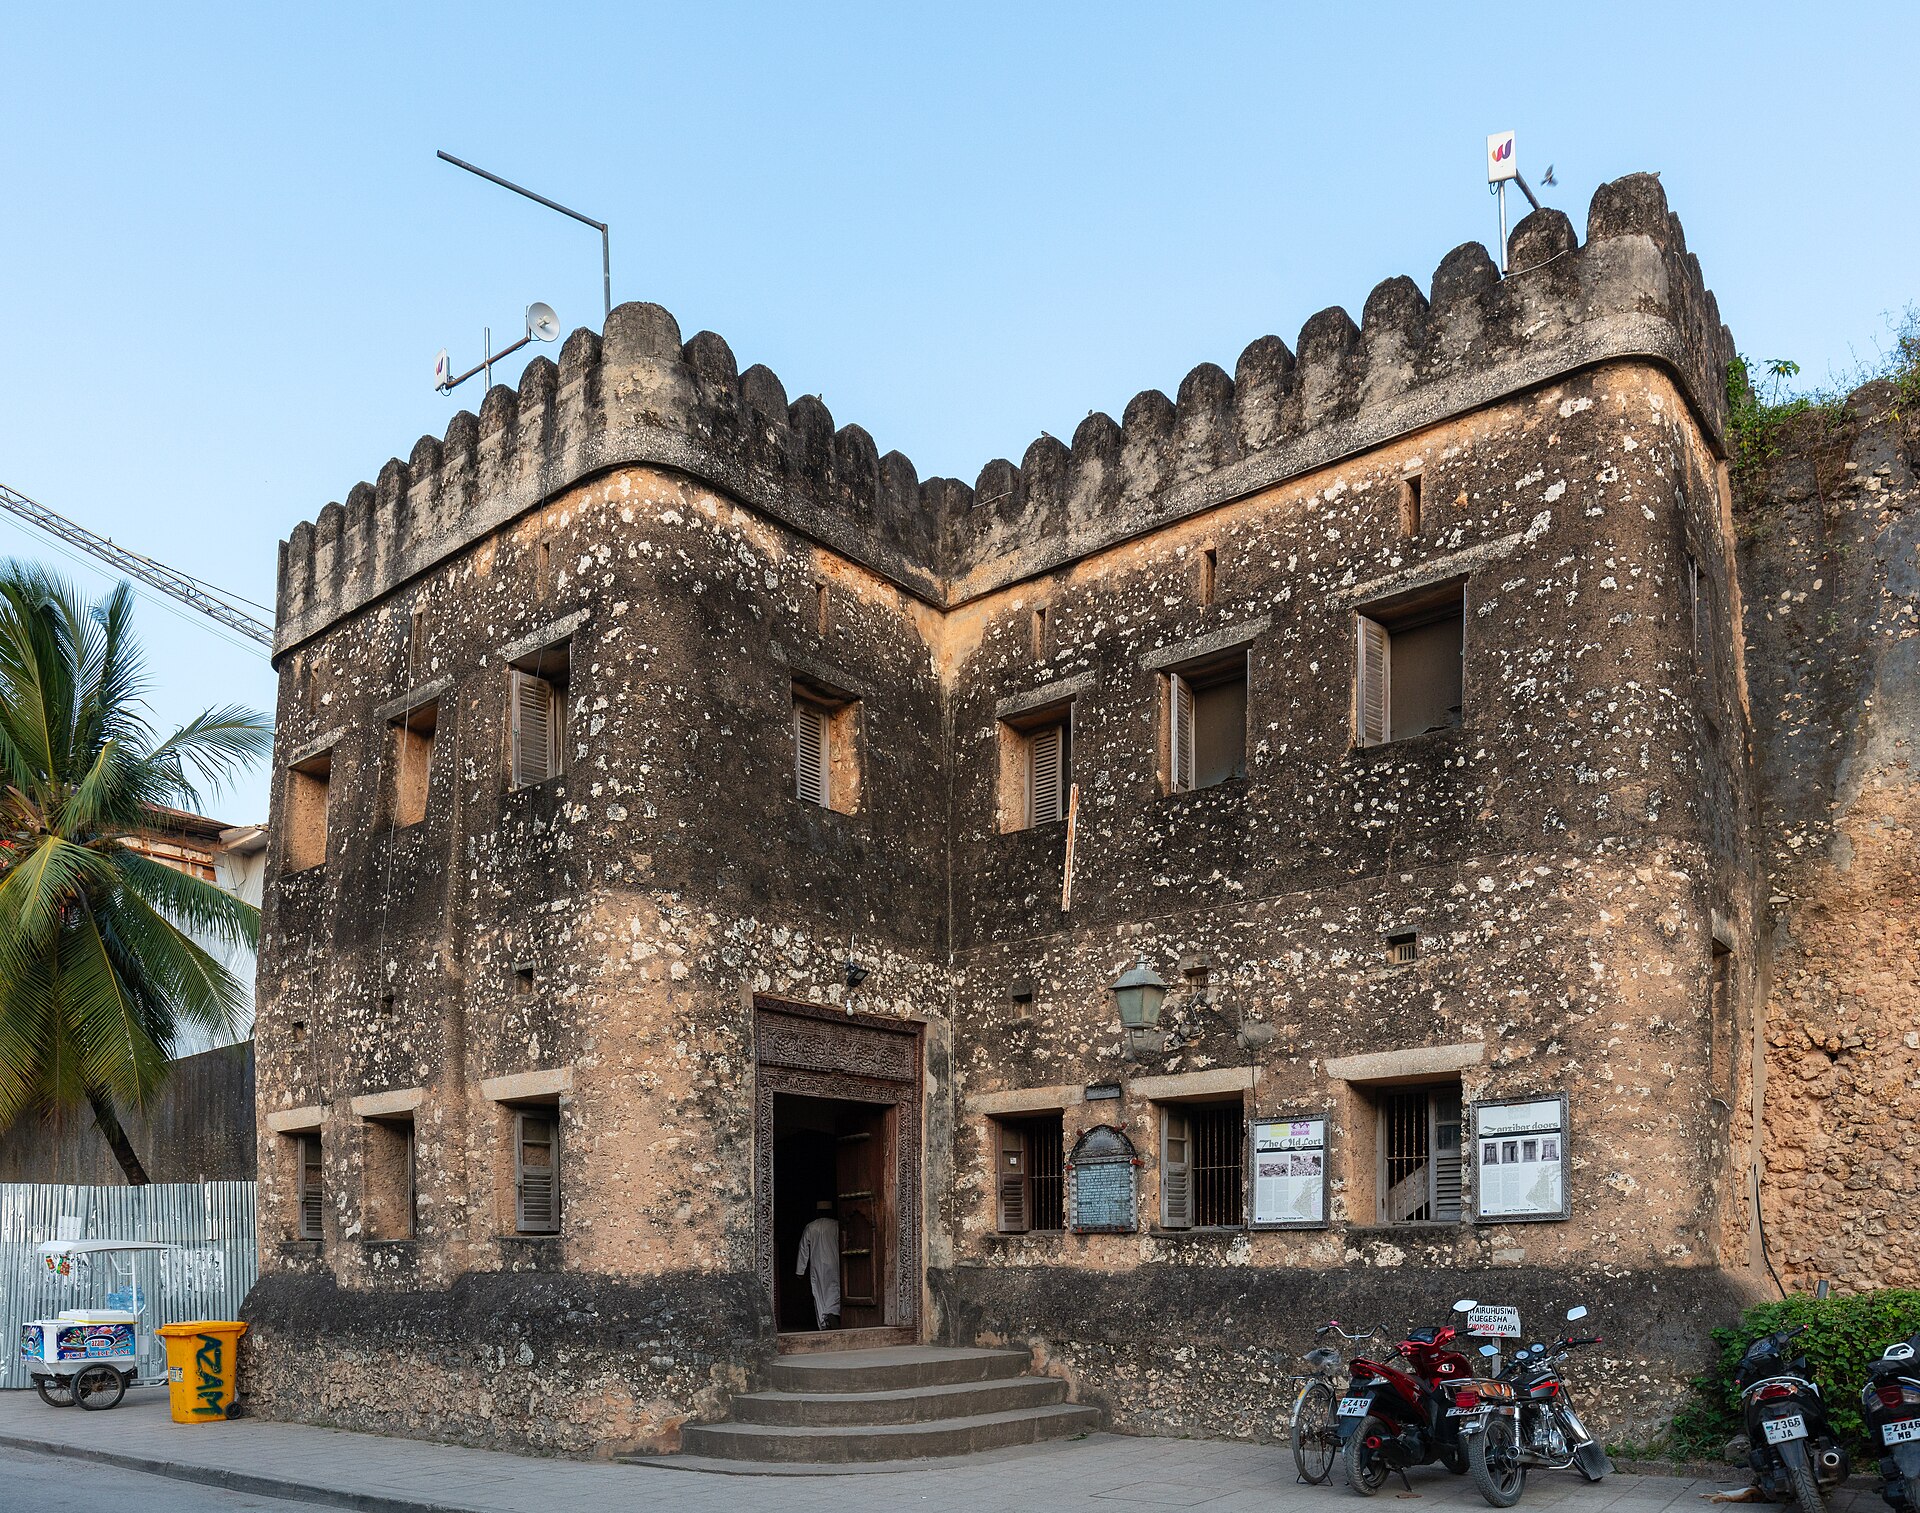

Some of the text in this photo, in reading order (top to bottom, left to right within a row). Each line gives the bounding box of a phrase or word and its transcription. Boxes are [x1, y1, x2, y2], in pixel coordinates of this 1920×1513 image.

[1483, 1123, 1530, 1136] Zanzibar
[1532, 1122, 1558, 1131] doors
[1259, 1139, 1279, 1150] The
[88, 1349, 131, 1357] CREAM
[192, 1333, 223, 1415] AZAM
[1773, 1417, 1800, 1430] Z366
[1892, 1420, 1920, 1432] Z846
[1781, 1430, 1793, 1438] JA
[1898, 1431, 1911, 1440] MB
